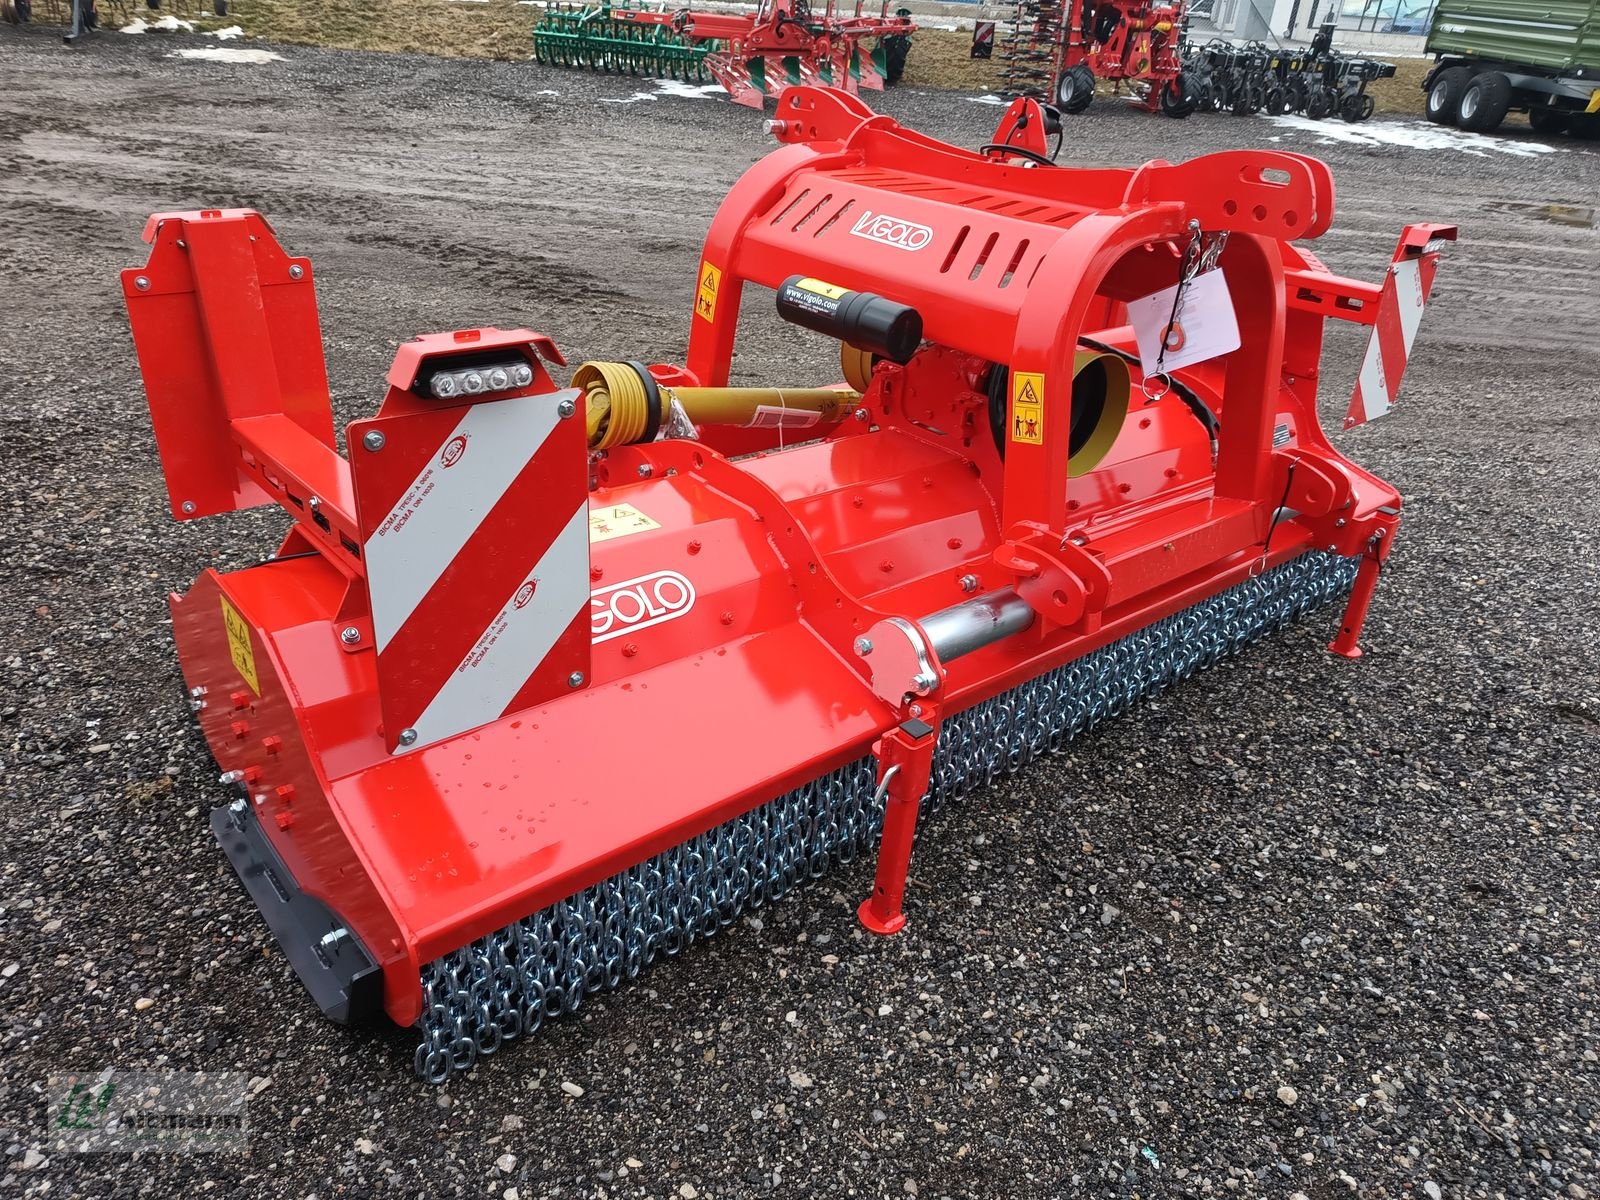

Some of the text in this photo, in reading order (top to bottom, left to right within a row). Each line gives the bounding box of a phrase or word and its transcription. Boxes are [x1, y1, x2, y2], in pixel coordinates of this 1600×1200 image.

[849, 210, 933, 250] VIGOLO
[786, 288, 838, 311] www.vigolo.com
[379, 513, 399, 536] BICMA
[393, 509, 414, 533] BICMA
[413, 497, 424, 508] DIN
[458, 651, 477, 672] BICMA
[471, 646, 489, 668] BICMA
[488, 635, 498, 646] DIN
